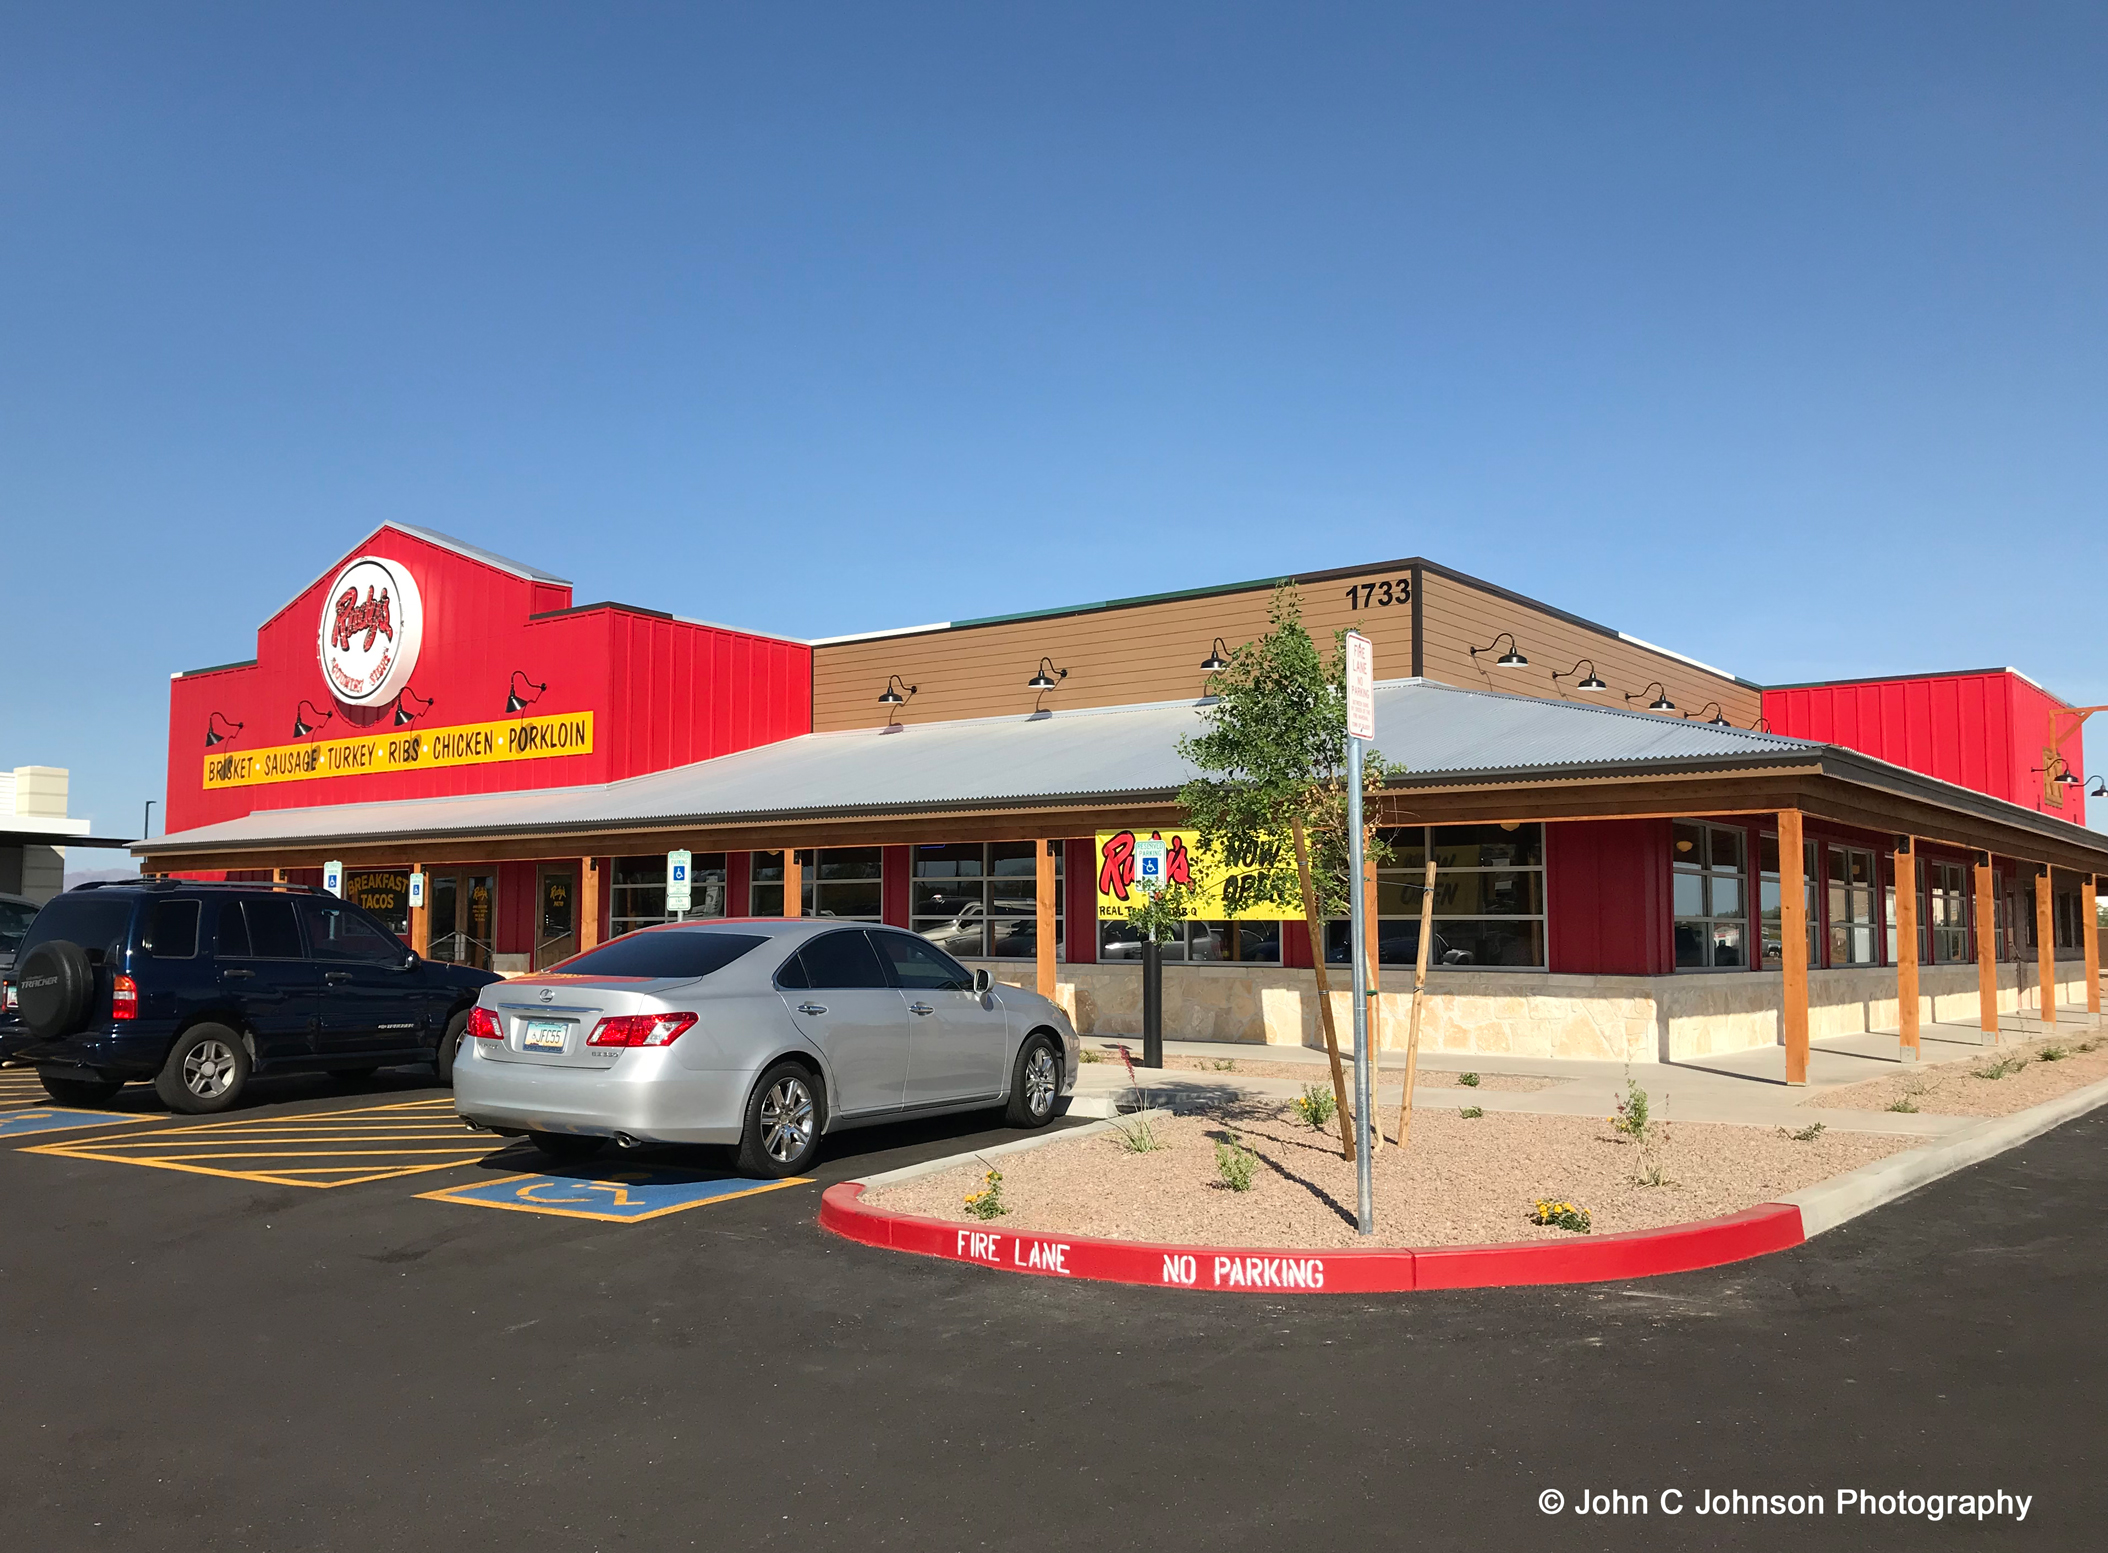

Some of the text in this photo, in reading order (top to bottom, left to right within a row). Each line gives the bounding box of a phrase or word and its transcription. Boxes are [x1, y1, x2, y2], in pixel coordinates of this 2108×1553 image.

[1345, 578, 1411, 610] 1733
[331, 585, 394, 652] Rudy's
[1353, 643, 1366, 660] FIRE
[1352, 659, 1368, 675] LANE
[208, 719, 586, 782] BRISKET SAUSAGE TURKEY RIBS CHICKEN PORKLOIN
[1137, 842, 1164, 850] RESERVED
[347, 873, 409, 896] BREAKFAST
[360, 893, 395, 910] TACOS
[1099, 906, 1123, 916] REAL
[21, 976, 58, 988] TRACKER
[957, 1230, 1071, 1274] FIRE LANE
[1163, 1254, 1324, 1288] NO PARKING
